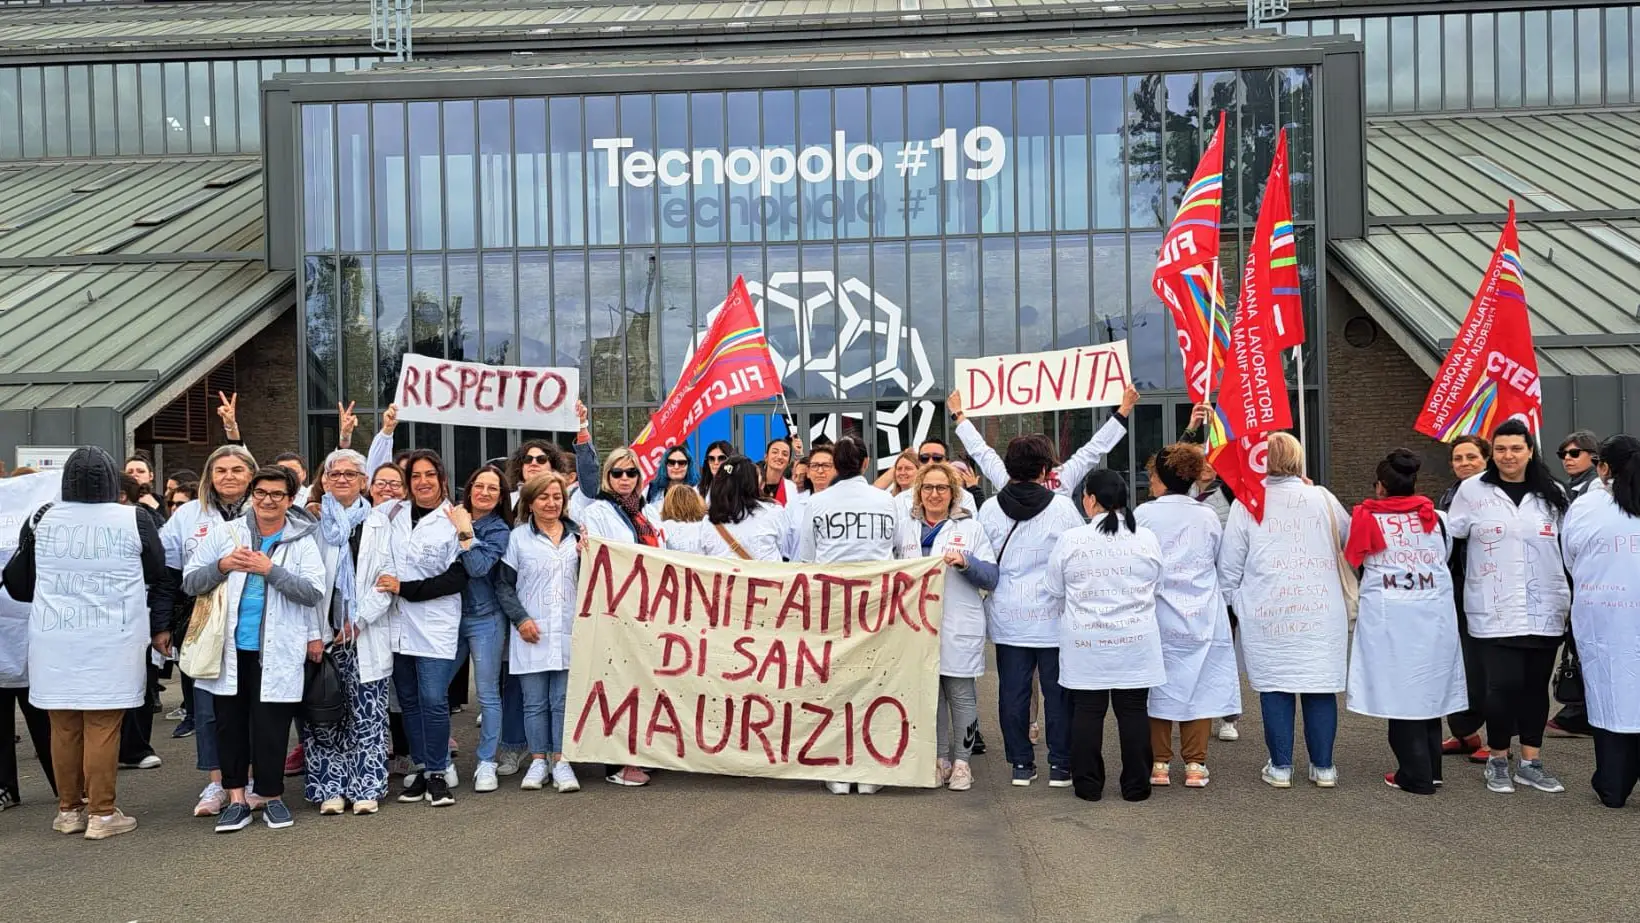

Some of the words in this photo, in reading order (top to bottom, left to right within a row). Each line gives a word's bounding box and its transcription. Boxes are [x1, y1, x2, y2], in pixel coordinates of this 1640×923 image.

[592, 130, 883, 196] Tecnopolo
[894, 125, 1006, 181] #19
[402, 363, 568, 414] RISPETTO
[966, 346, 1128, 411] DIGNITÀ
[1232, 326, 1258, 429] MANIFATTURE
[1248, 326, 1274, 423] LAVORATORI
[578, 543, 942, 638] MANIFATTURE
[653, 627, 707, 676] DI
[722, 636, 833, 689] SAN
[572, 680, 910, 767] MAURIZIO
